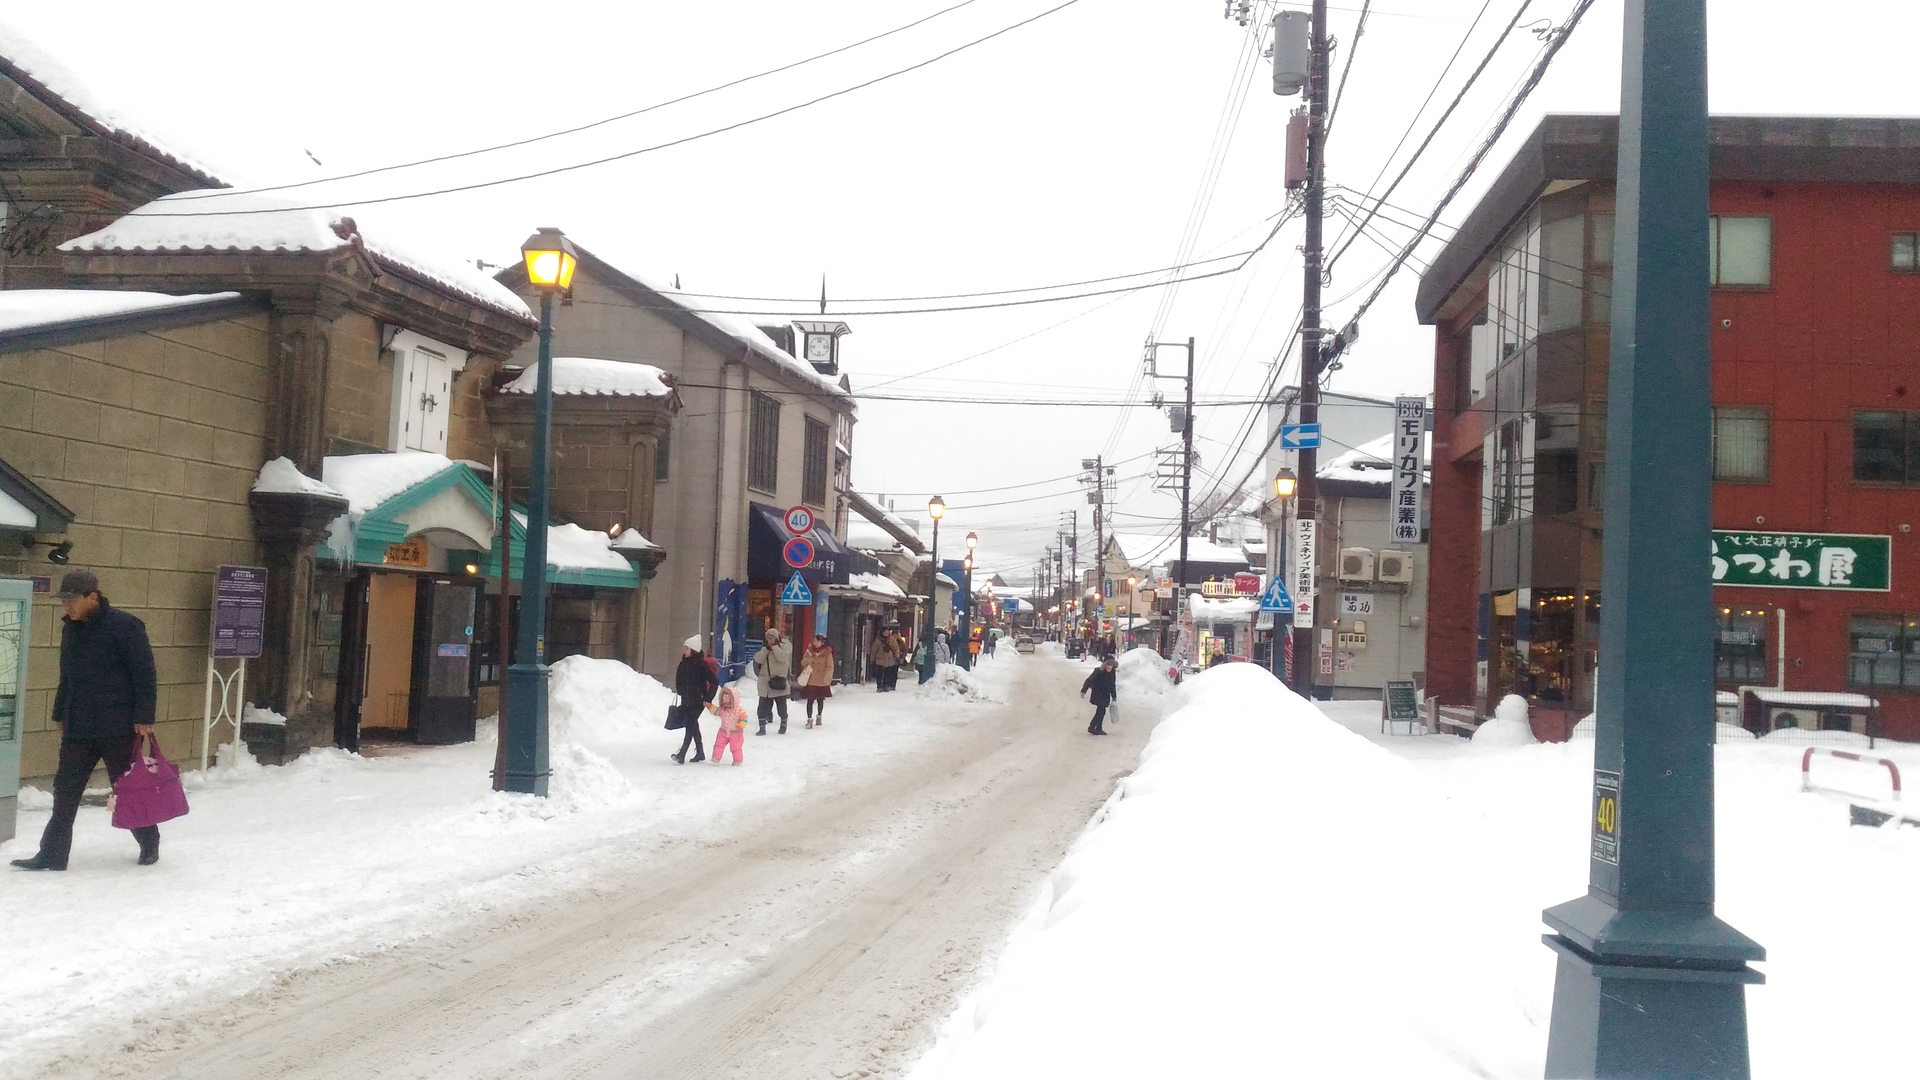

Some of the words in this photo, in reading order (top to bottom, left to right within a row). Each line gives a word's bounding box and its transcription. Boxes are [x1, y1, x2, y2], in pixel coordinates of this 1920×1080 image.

[1399, 401, 1424, 419] BIG
[790, 513, 808, 527] 40
[1745, 535, 1803, 549] 大正硝子
[1237, 578, 1258, 586] ラーメン
[1597, 796, 1615, 834] 40
